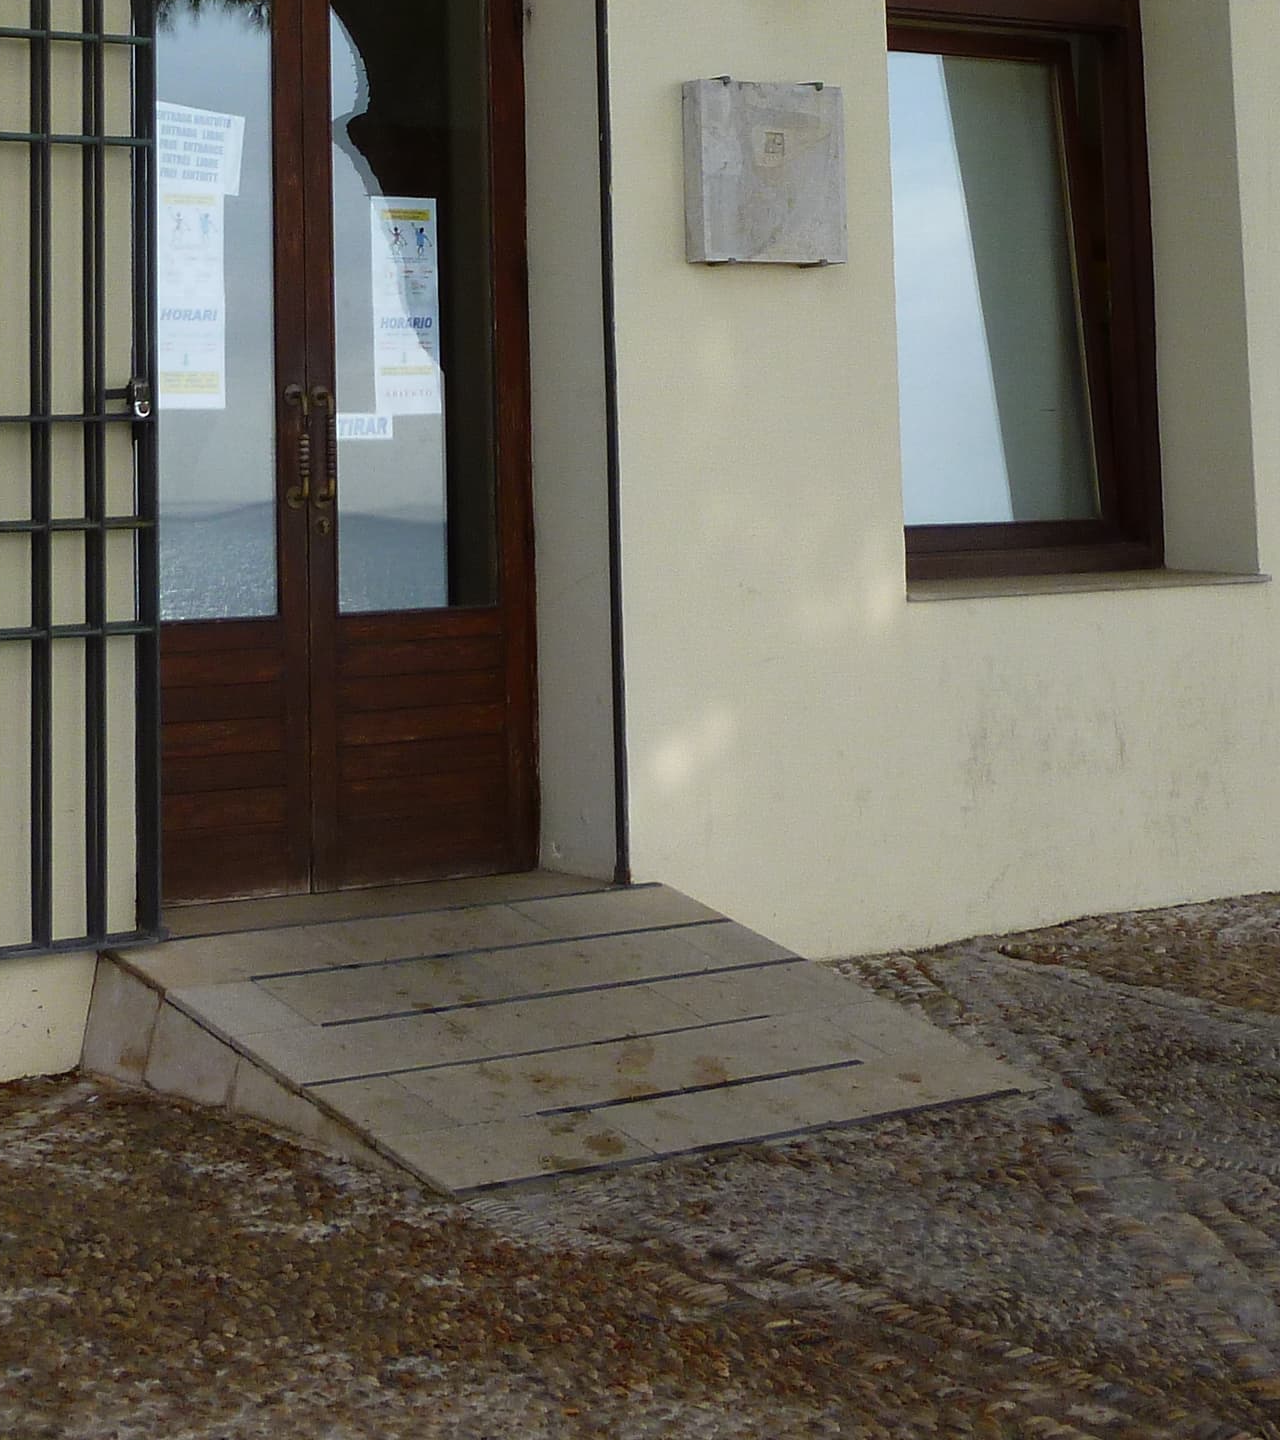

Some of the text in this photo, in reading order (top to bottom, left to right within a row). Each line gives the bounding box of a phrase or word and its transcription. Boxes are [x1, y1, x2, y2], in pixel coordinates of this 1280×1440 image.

[160, 307, 218, 321] HORARI
[380, 317, 433, 330] HORARIO
[339, 416, 389, 437] TIRAR
